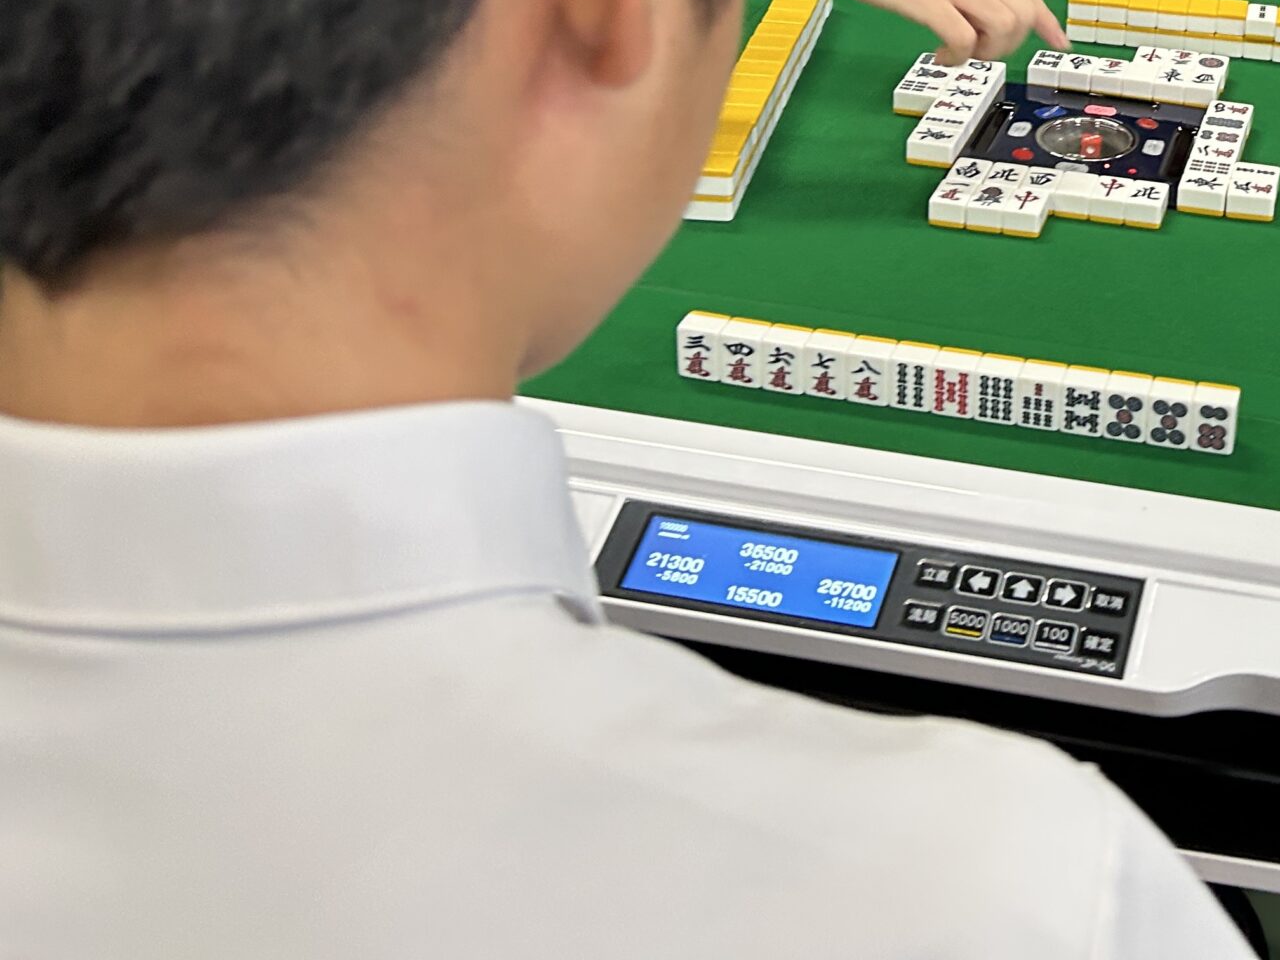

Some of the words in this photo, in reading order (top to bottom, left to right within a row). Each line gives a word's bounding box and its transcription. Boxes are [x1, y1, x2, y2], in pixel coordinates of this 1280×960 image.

[1100, 178, 1125, 197] 中
[1015, 190, 1040, 210] 中
[646, 551, 704, 573] 21300
[739, 542, 799, 563] 36500
[744, 560, 793, 575] -21000
[726, 585, 783, 607] 15500
[816, 578, 877, 601] 26700
[823, 596, 871, 613] -11200
[950, 612, 986, 629] 5000
[993, 618, 1029, 636] 1000
[1041, 626, 1070, 642] 100
